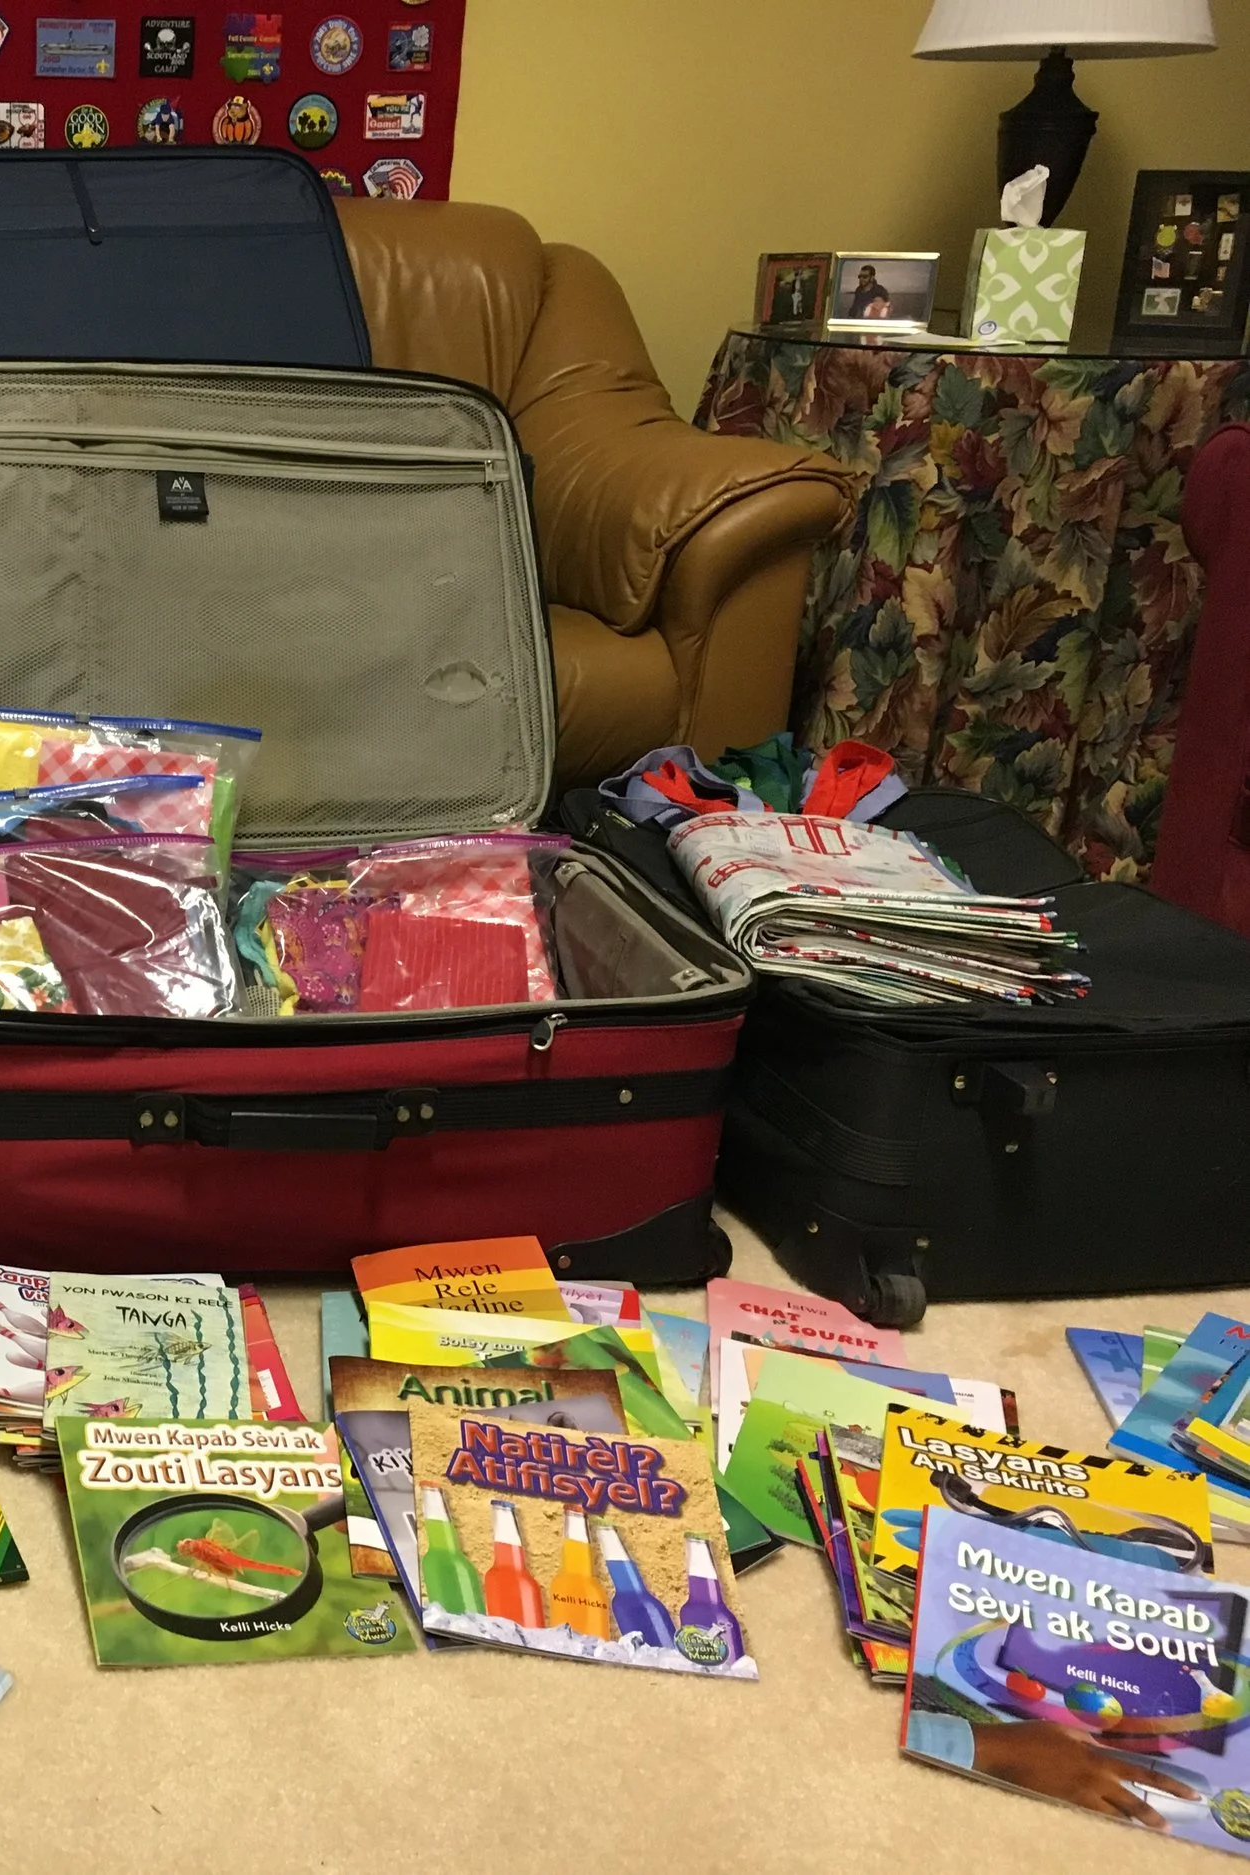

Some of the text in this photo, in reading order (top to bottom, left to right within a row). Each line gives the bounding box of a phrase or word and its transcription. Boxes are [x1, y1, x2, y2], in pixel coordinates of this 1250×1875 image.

[145, 20, 190, 28] ADVENTURE
[146, 52, 187, 60] SCOUTLAND
[154, 65, 178, 73] CAMP
[68, 123, 105, 134] TURN
[71, 113, 103, 124] GOOD
[414, 1263, 502, 1283] Mwen
[63, 1285, 96, 1296] YON
[101, 1288, 169, 1302] PWASON
[175, 1297, 192, 1305] KI
[434, 1280, 499, 1299] Rele
[116, 1305, 187, 1330] TANGA
[739, 1302, 800, 1322] CHAT
[786, 1301, 828, 1317] Istwa
[789, 1325, 879, 1350] SOURIT
[397, 1374, 553, 1410] Animal
[94, 1427, 321, 1450] Mwen Kapab Sèvi ak
[463, 1421, 662, 1474] Natirèl?
[372, 1449, 413, 1473] Kij
[901, 1428, 1090, 1482] Lasyans
[85, 1455, 343, 1494] Zouti Lasyans
[450, 1448, 683, 1513] Atifisyèl?
[914, 1454, 1088, 1500] An Sekirite
[956, 1541, 1212, 1633] Mwen Kapab
[552, 1593, 609, 1611] Kelli Hicks
[219, 1621, 292, 1633] Kelli Hicks
[947, 1582, 1220, 1667] Sèvi ak Souri
[1066, 1663, 1142, 1696] Kelli Hicks
